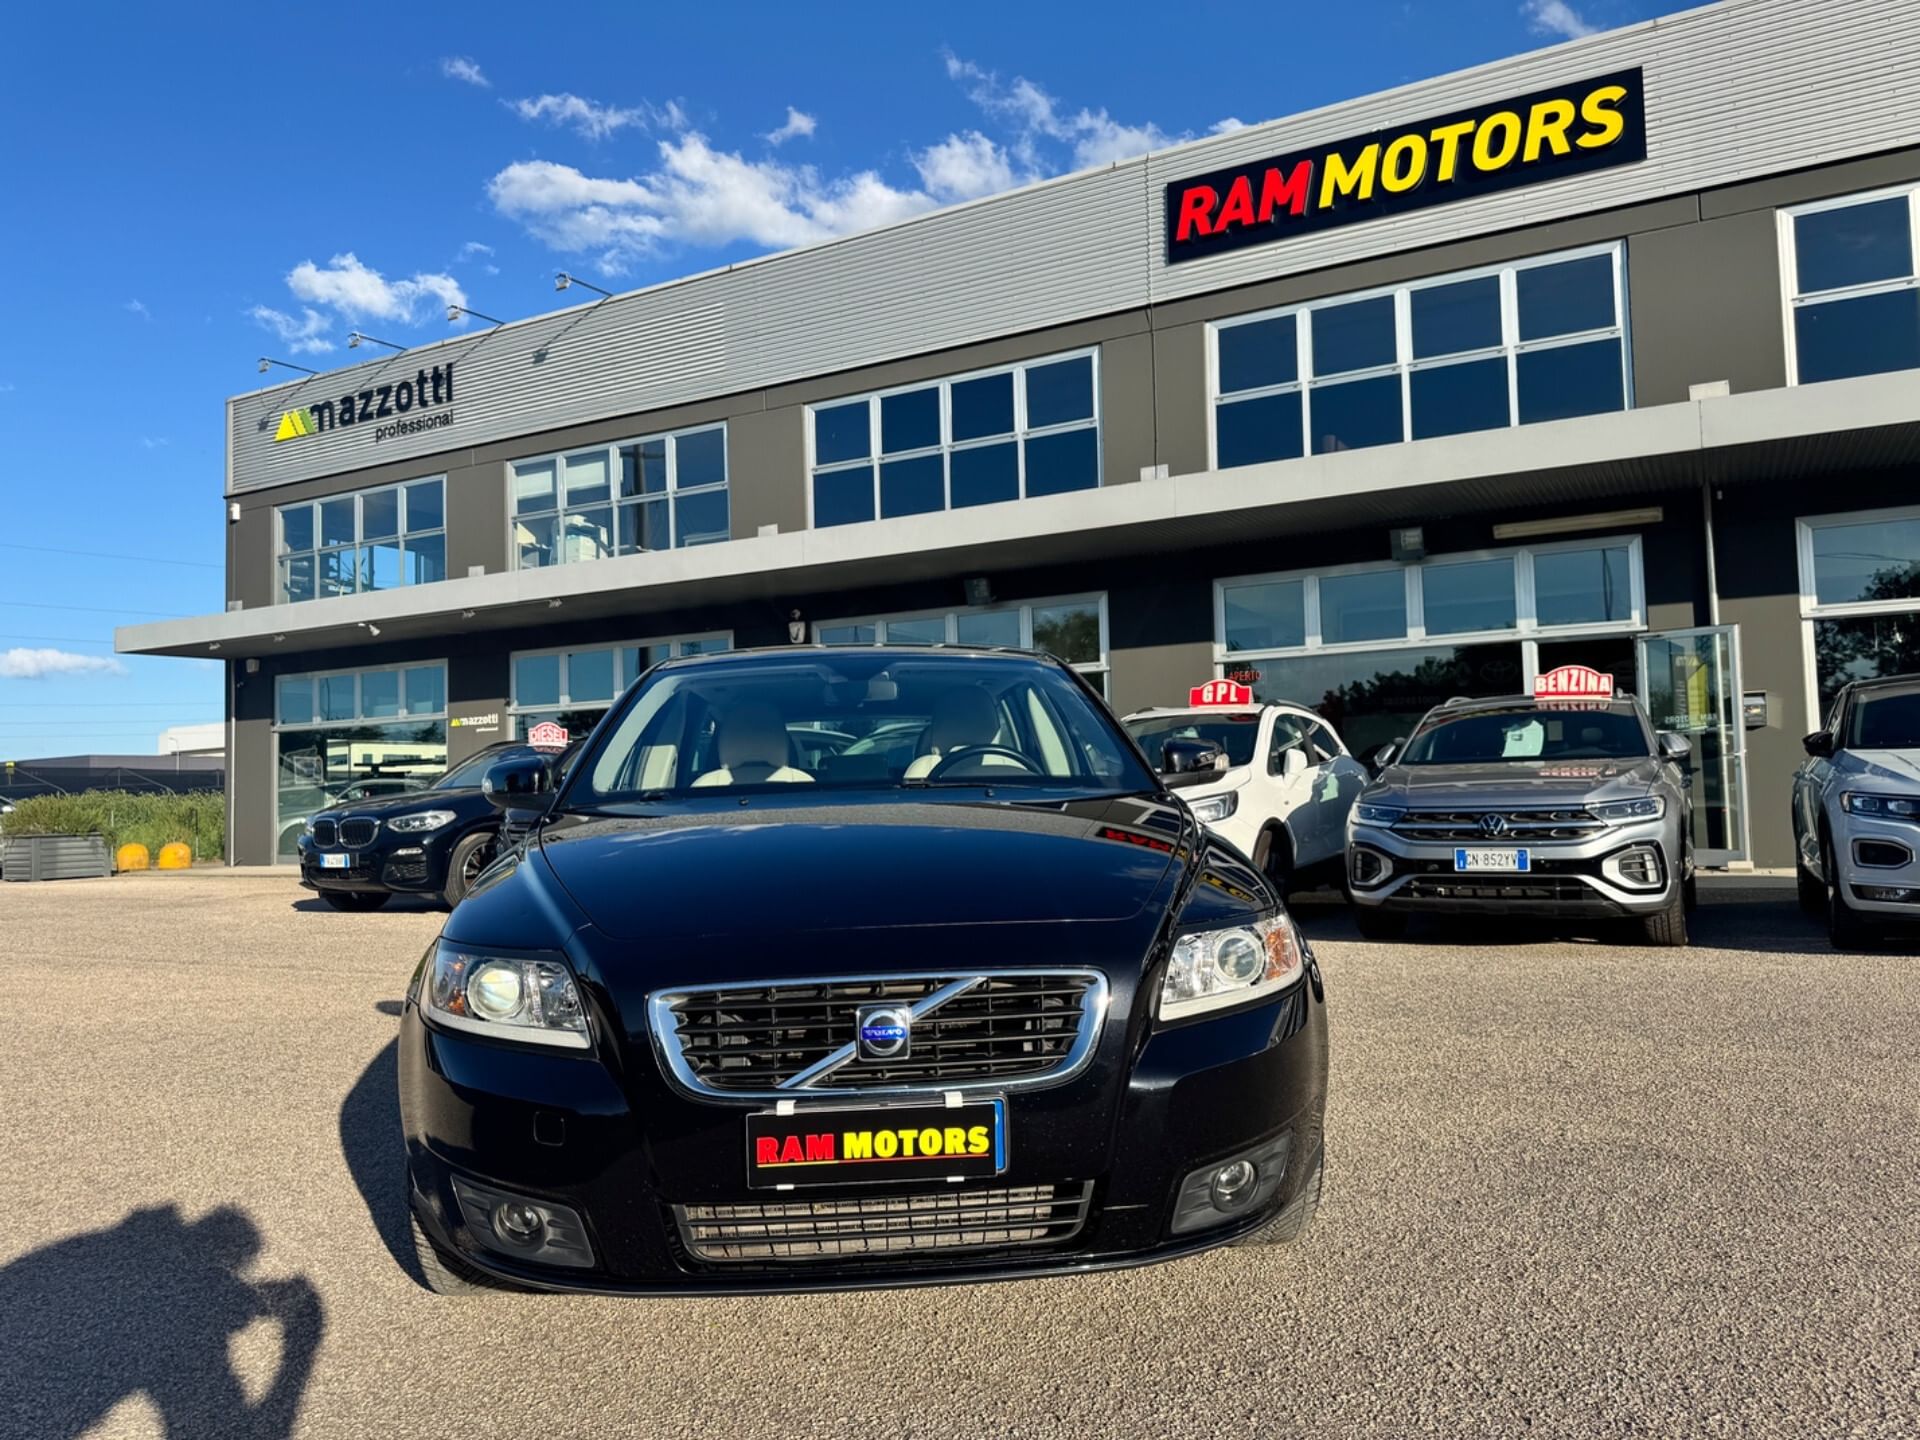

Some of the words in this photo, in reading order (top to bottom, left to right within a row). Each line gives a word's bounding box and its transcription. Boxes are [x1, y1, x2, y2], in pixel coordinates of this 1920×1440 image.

[1175, 159, 1314, 242] RAM
[1318, 85, 1628, 210] MOTORS
[309, 362, 454, 433] mazzotti
[375, 410, 455, 444] professional
[1228, 669, 1262, 681] APERTO
[1535, 668, 1611, 693] BENZINA
[1202, 682, 1238, 703] GPL
[460, 713, 499, 726] mazzotti
[864, 1029, 903, 1037] VOLVO
[756, 1133, 835, 1164] RAM
[843, 1126, 990, 1159] MOTORS
